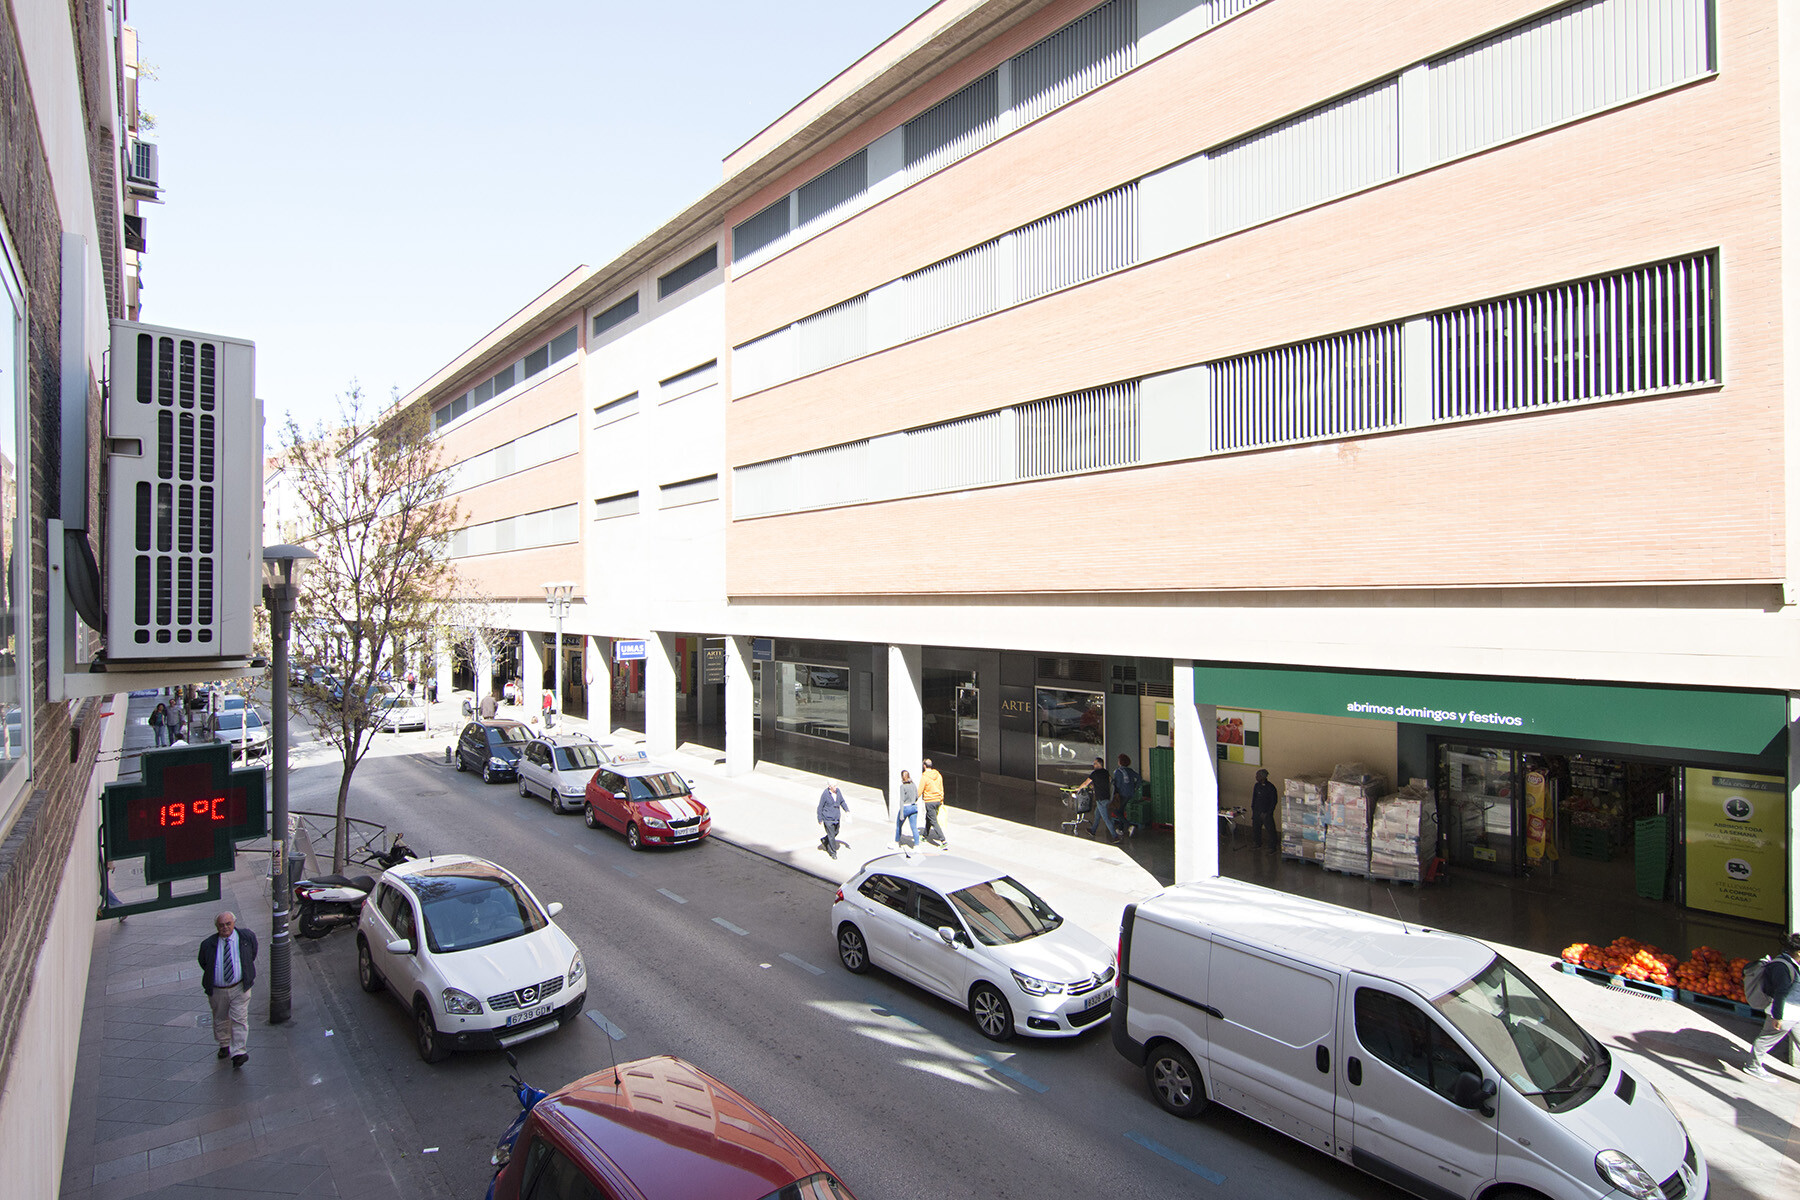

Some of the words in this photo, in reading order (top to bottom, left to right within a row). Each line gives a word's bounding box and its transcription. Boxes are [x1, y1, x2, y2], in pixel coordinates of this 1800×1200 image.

[620, 645, 645, 653] UMAS
[1001, 700, 1032, 713] ARTE
[1346, 701, 1395, 716] abrimos
[1395, 705, 1457, 722] domingos
[1458, 711, 1467, 724] y
[1468, 711, 1523, 727] festivos
[1713, 822, 1743, 831] ABRIMOS
[1729, 830, 1757, 839] SEMANA
[1729, 889, 1757, 898] COMPRA
